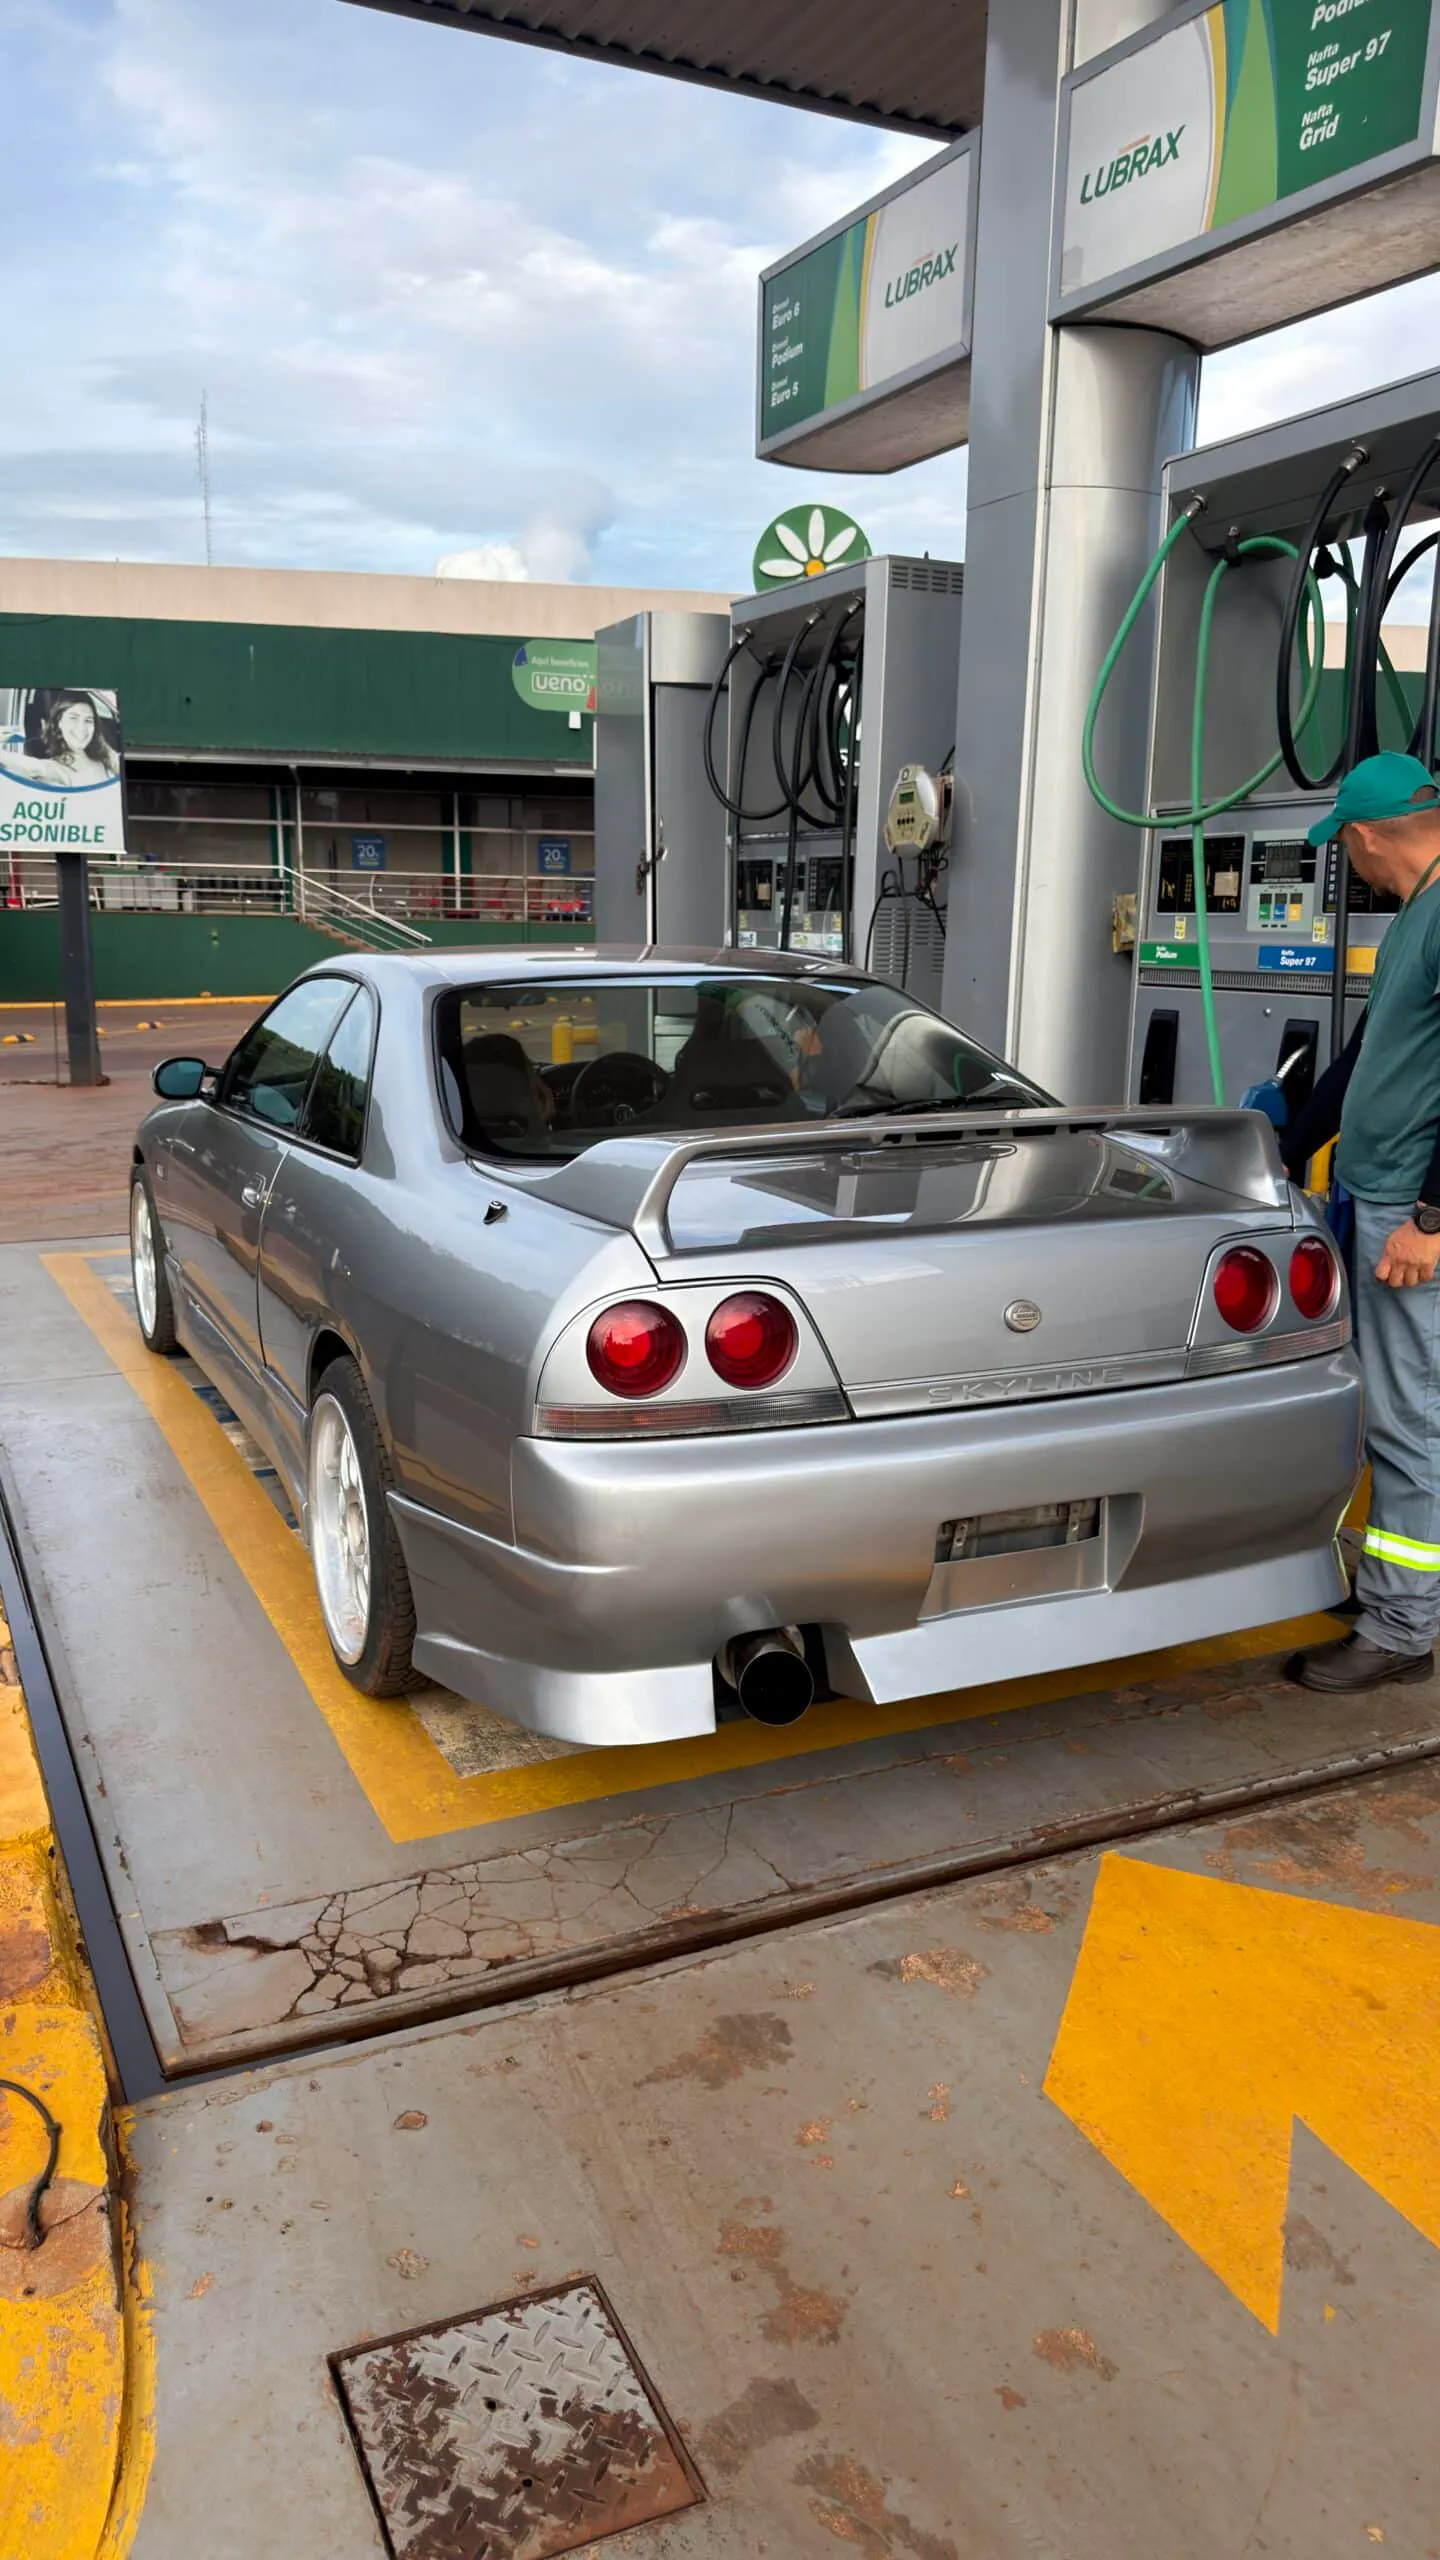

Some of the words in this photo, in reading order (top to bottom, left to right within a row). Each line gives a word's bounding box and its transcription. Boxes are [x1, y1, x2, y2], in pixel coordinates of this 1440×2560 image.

[1311, 0, 1370, 31] Pod
[1305, 49, 1362, 90] Super
[1364, 29, 1392, 61] 97
[1307, 43, 1339, 68] Nafta
[1301, 103, 1333, 127] Nafta
[1299, 113, 1340, 150] Grid
[1080, 124, 1186, 204] LUBRAX
[884, 243, 958, 308] LUBRAX
[772, 310, 792, 330] Euro
[771, 342, 803, 369] Podium
[771, 389, 791, 407] Euro
[792, 381, 799, 396] 5
[535, 675, 586, 692] ueno
[12, 797, 67, 822] AQUÍ
[0, 823, 105, 843] SPONIBLE
[1280, 956, 1304, 968] Super
[1305, 956, 1317, 966] 97
[928, 1367, 1125, 1404] SKYLINE
